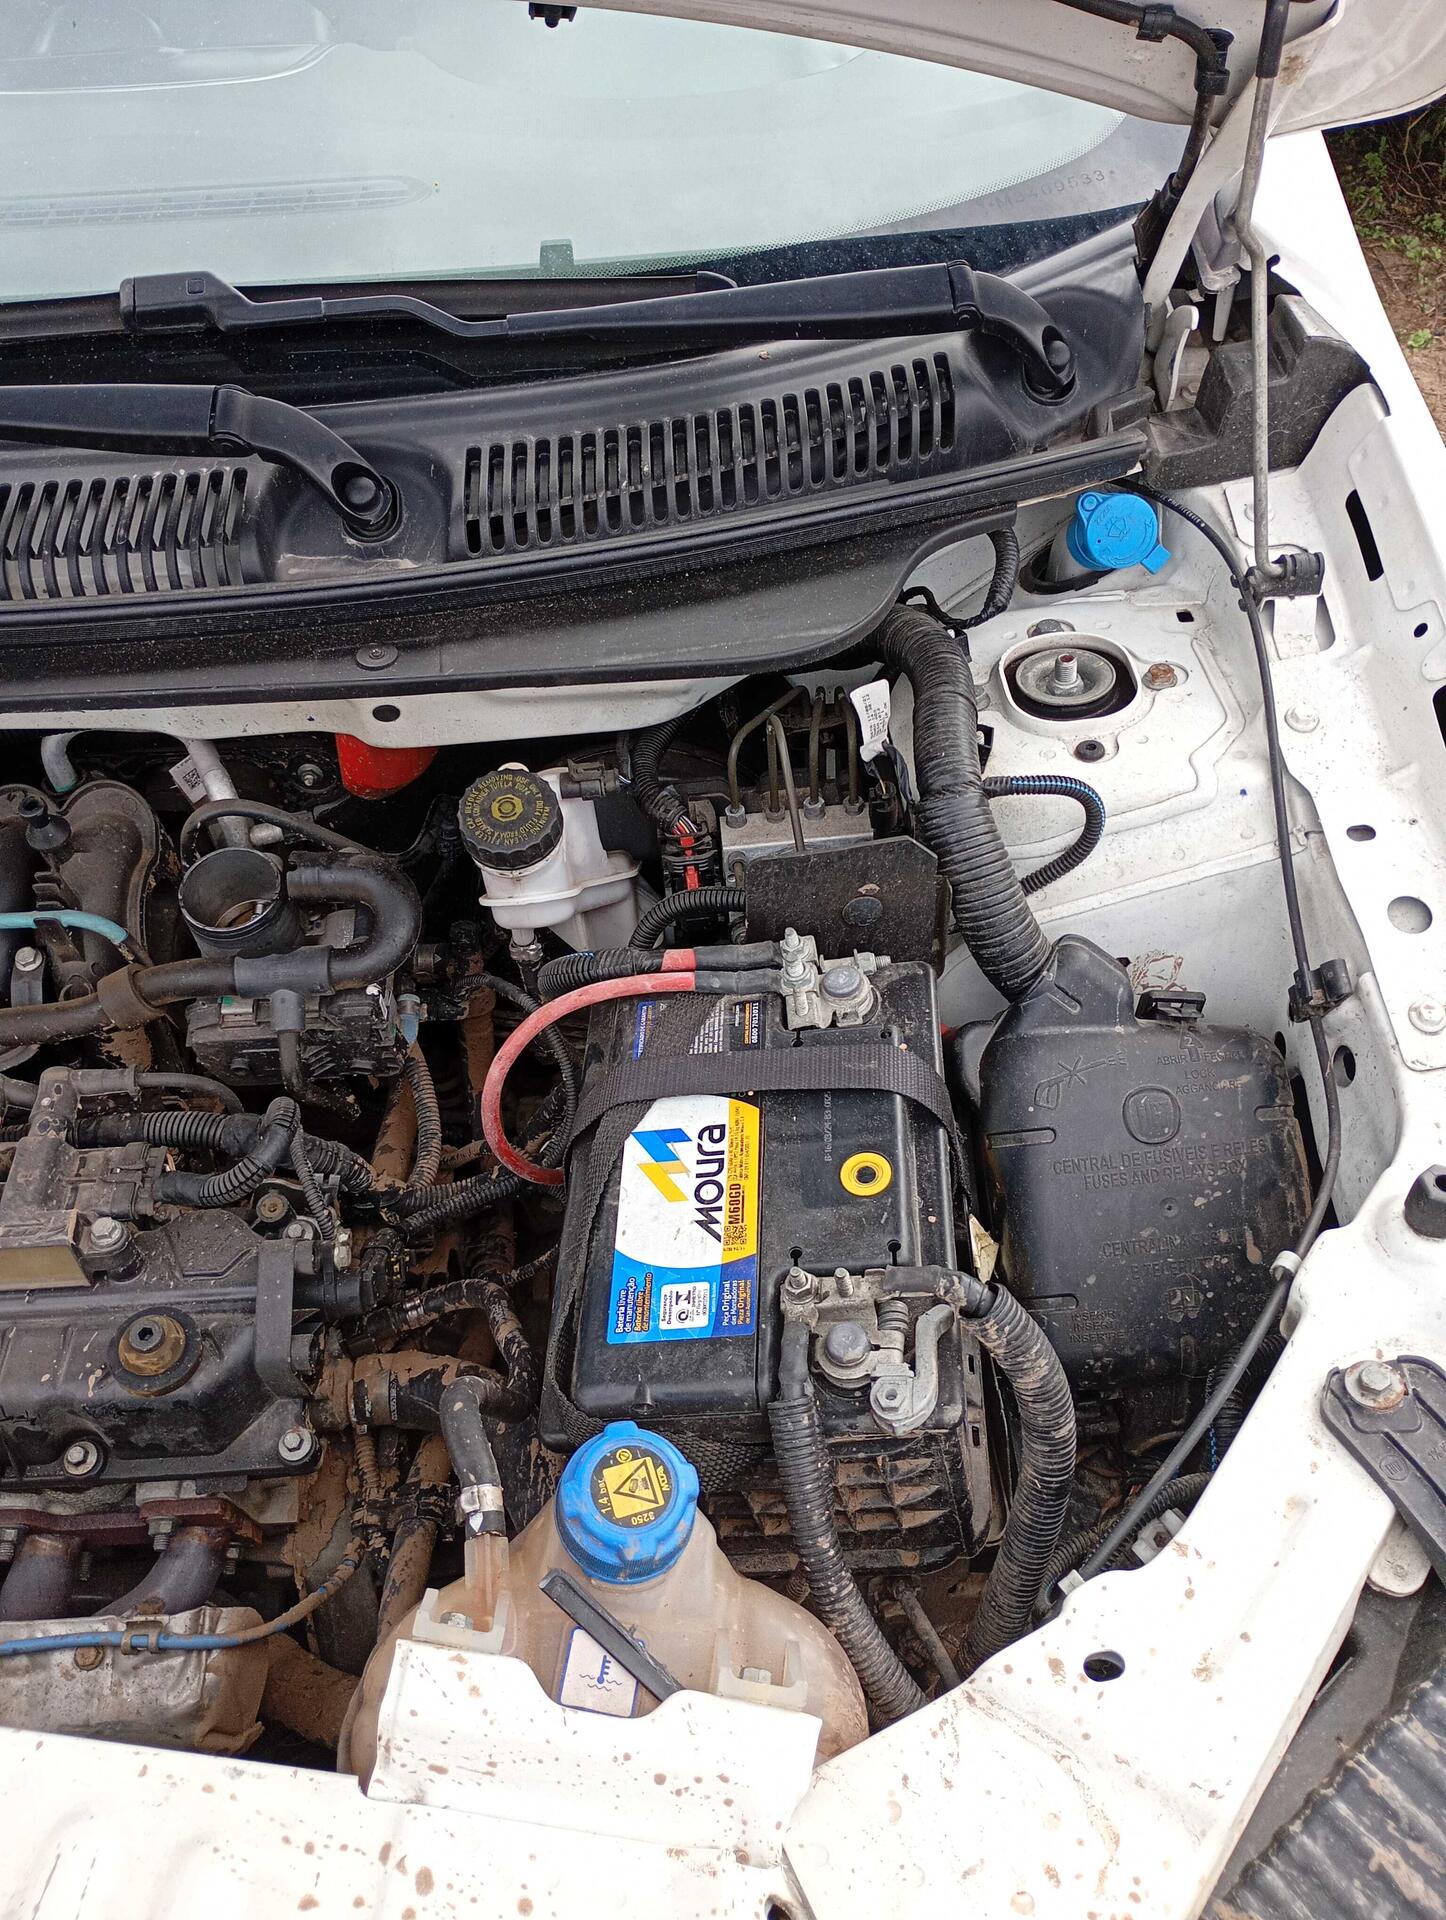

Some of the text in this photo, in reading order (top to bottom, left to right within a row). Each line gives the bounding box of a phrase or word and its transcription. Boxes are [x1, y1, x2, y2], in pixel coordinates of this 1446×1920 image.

[1184, 1036, 1195, 1047] 2
[1156, 1054, 1188, 1066] ABRIR
[1184, 1068, 1217, 1080] LOCK
[1175, 1080, 1243, 1095] AGGANCIARE
[1053, 1154, 1119, 1176] CENTRAL
[1120, 1152, 1144, 1169] DE
[1210, 1143, 1220, 1158] E
[1083, 1157, 1248, 1191] FUSES AND RELAYS BOX
[728, 1183, 742, 1225] M60GD
[615, 1289, 627, 1333] Bateria livre
[624, 1278, 637, 1332] de manutenção
[644, 1273, 652, 1322] mantenimiento
[721, 1280, 731, 1326] Peça Original
[737, 1280, 746, 1309] Original
[597, 1478, 613, 1514] 1.4 bar
[631, 1511, 655, 1525] 3250
